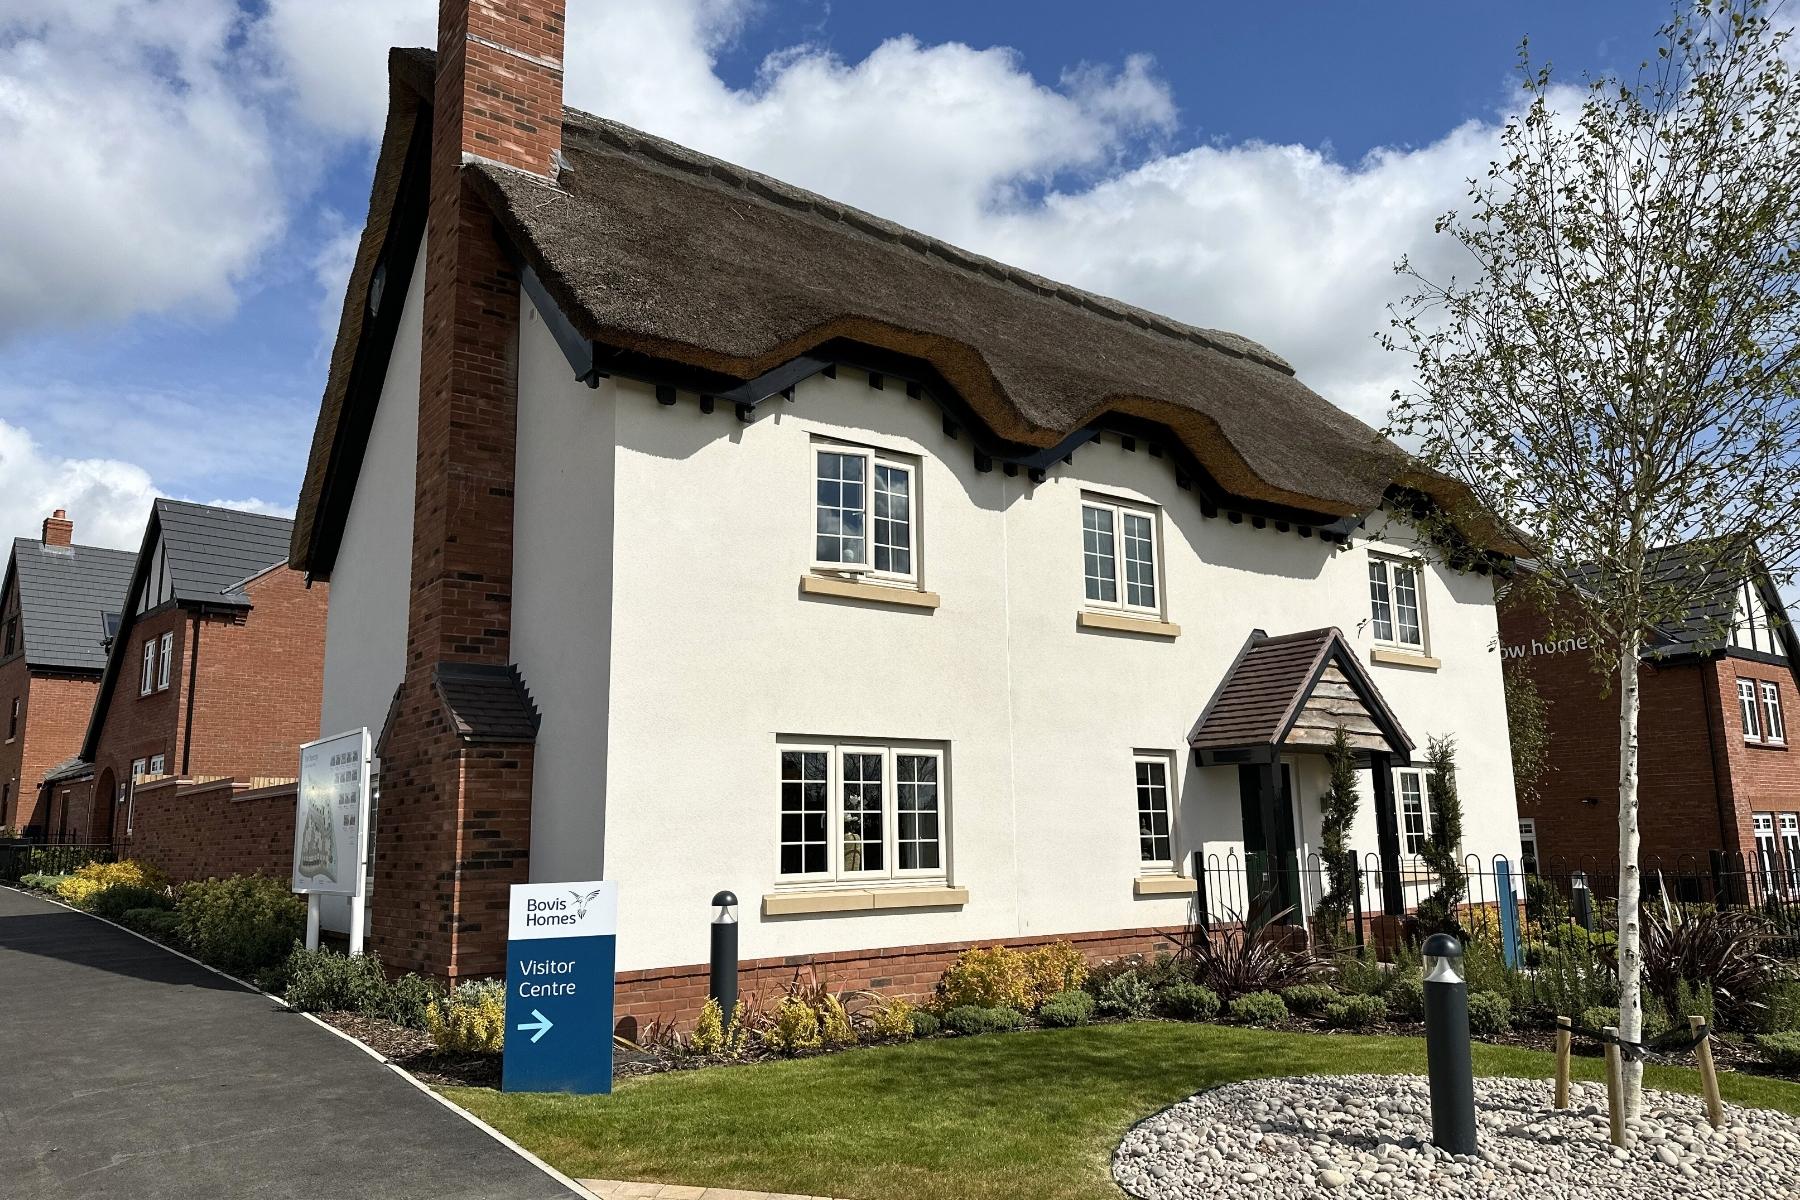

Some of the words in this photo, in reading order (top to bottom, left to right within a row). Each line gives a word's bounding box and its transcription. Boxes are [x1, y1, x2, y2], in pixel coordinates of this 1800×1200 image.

[1500, 644, 1526, 660] ow
[527, 897, 567, 912] Bovis
[526, 913, 577, 927] Homes
[520, 959, 576, 976] Visitor
[519, 981, 576, 998] Centre
